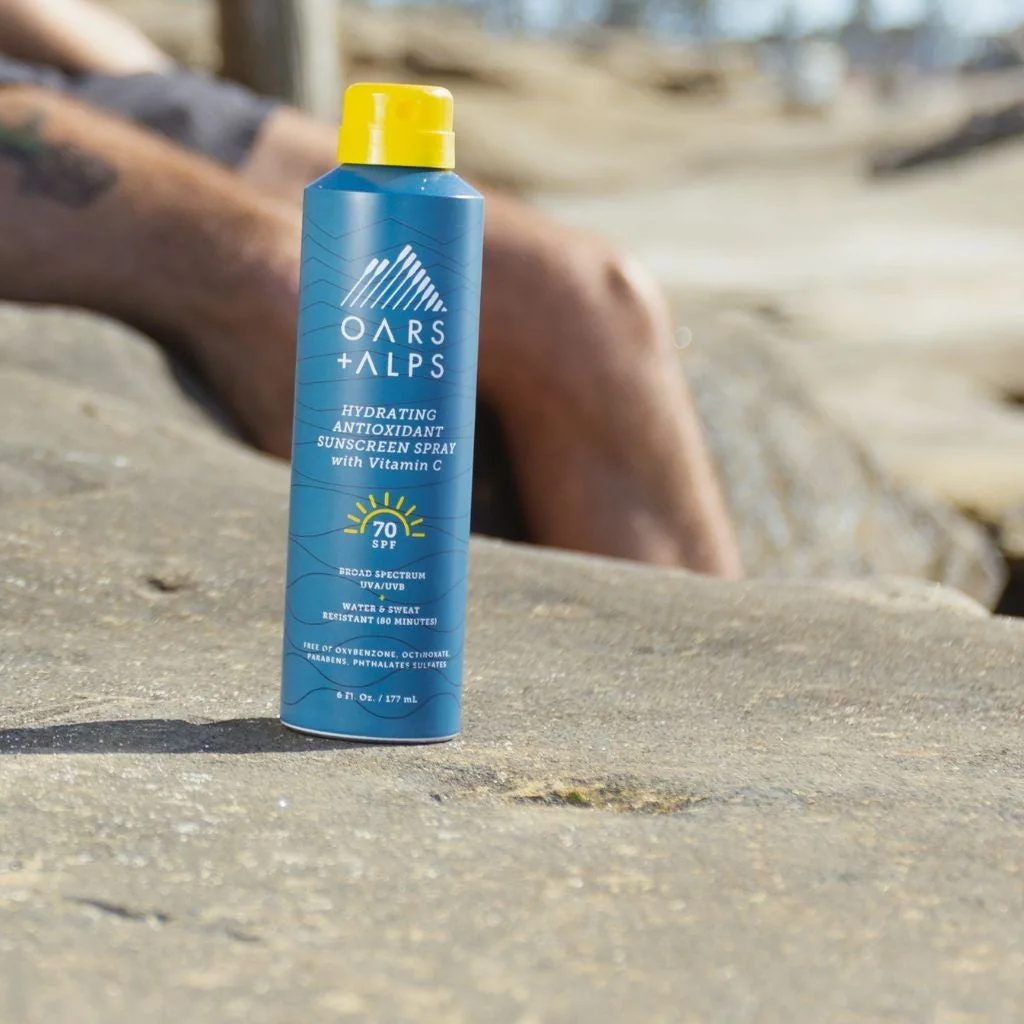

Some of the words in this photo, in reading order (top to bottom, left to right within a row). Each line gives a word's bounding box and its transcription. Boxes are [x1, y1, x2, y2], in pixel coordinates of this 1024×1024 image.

[341, 315, 445, 345] OARS
[341, 404, 437, 421] HYDRATING
[332, 421, 443, 438] ANTIOXIDANT
[317, 435, 410, 453] SUNSCREEN
[413, 442, 456, 455] SPRAY
[331, 455, 363, 468] with
[369, 456, 428, 471] Vitamin
[432, 459, 442, 472] C
[372, 520, 397, 538] 70
[371, 539, 397, 550] SPF
[338, 567, 372, 577] BROAD
[374, 570, 426, 580] SPECTRUM
[360, 580, 405, 591] UVA/UVB
[342, 602, 376, 613] WATER
[388, 606, 420, 614] SWEAT
[322, 611, 374, 624] RESISTANT
[376, 617, 392, 626] (80
[394, 617, 437, 626] MINUTES)
[303, 641, 320, 652] FREE
[412, 661, 447, 669] SULFATES
[336, 691, 343, 699] 6
[359, 693, 375, 702] Oz.
[385, 695, 401, 703] 177
[403, 695, 418, 703] mL
